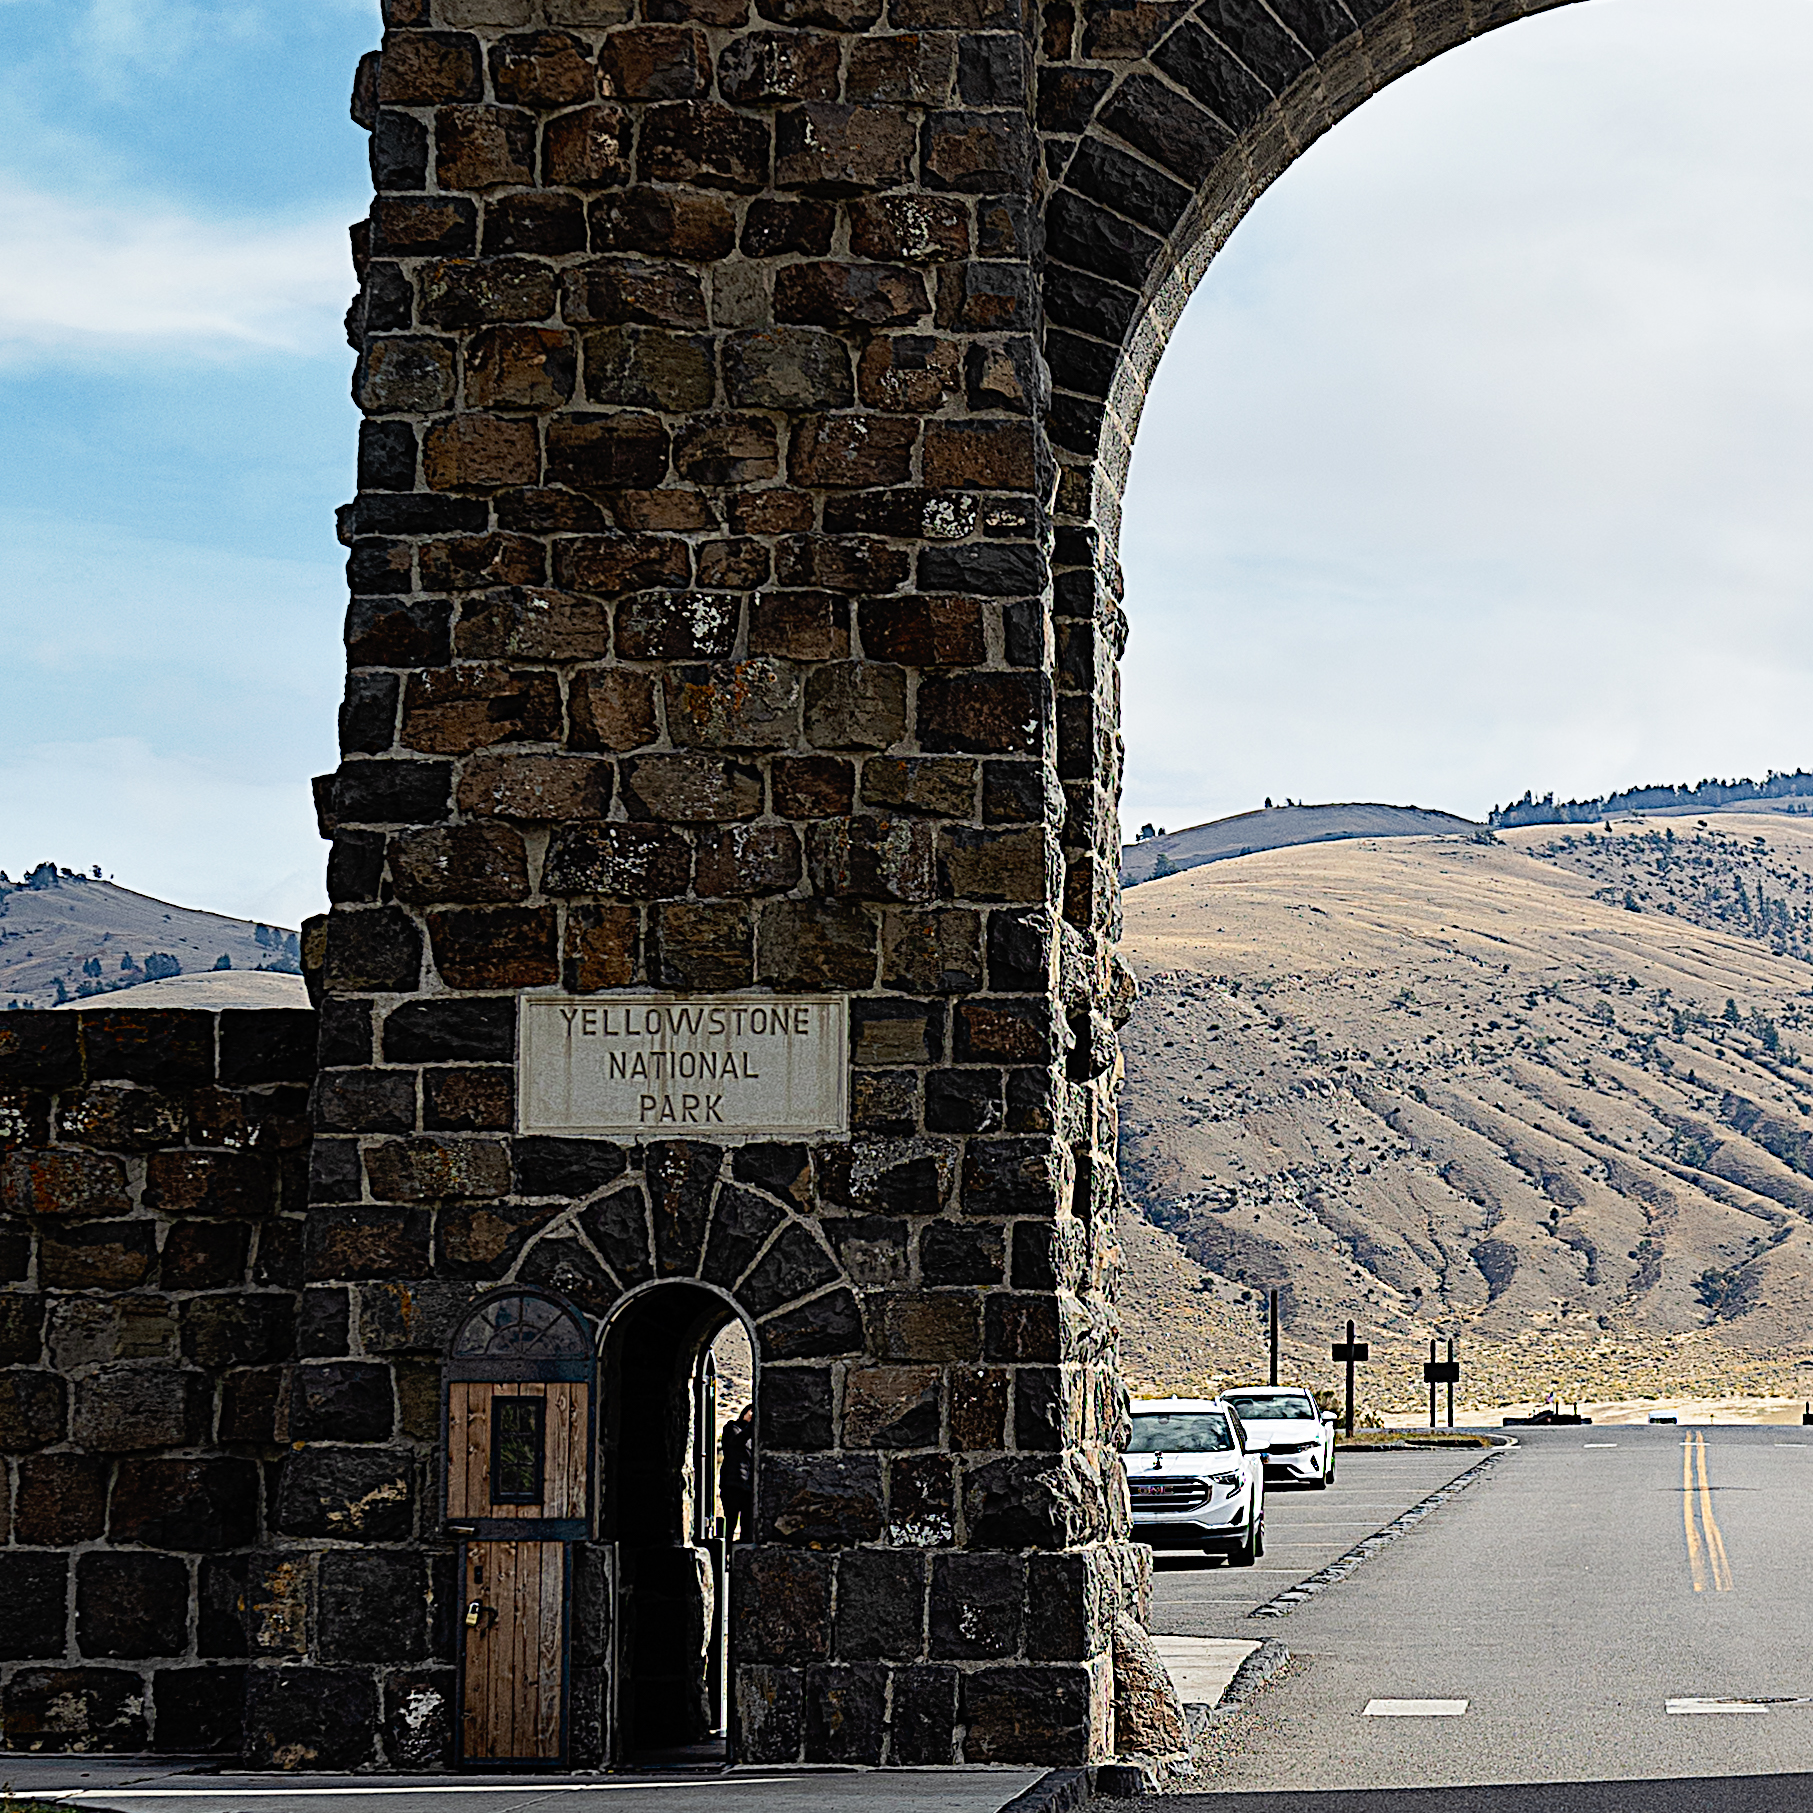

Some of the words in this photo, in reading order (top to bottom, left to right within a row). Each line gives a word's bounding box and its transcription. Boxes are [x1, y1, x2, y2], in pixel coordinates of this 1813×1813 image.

[559, 1007, 810, 1037] YELLOWSTONE
[608, 1051, 760, 1080] NATIONAL
[639, 1093, 724, 1123] PARK
